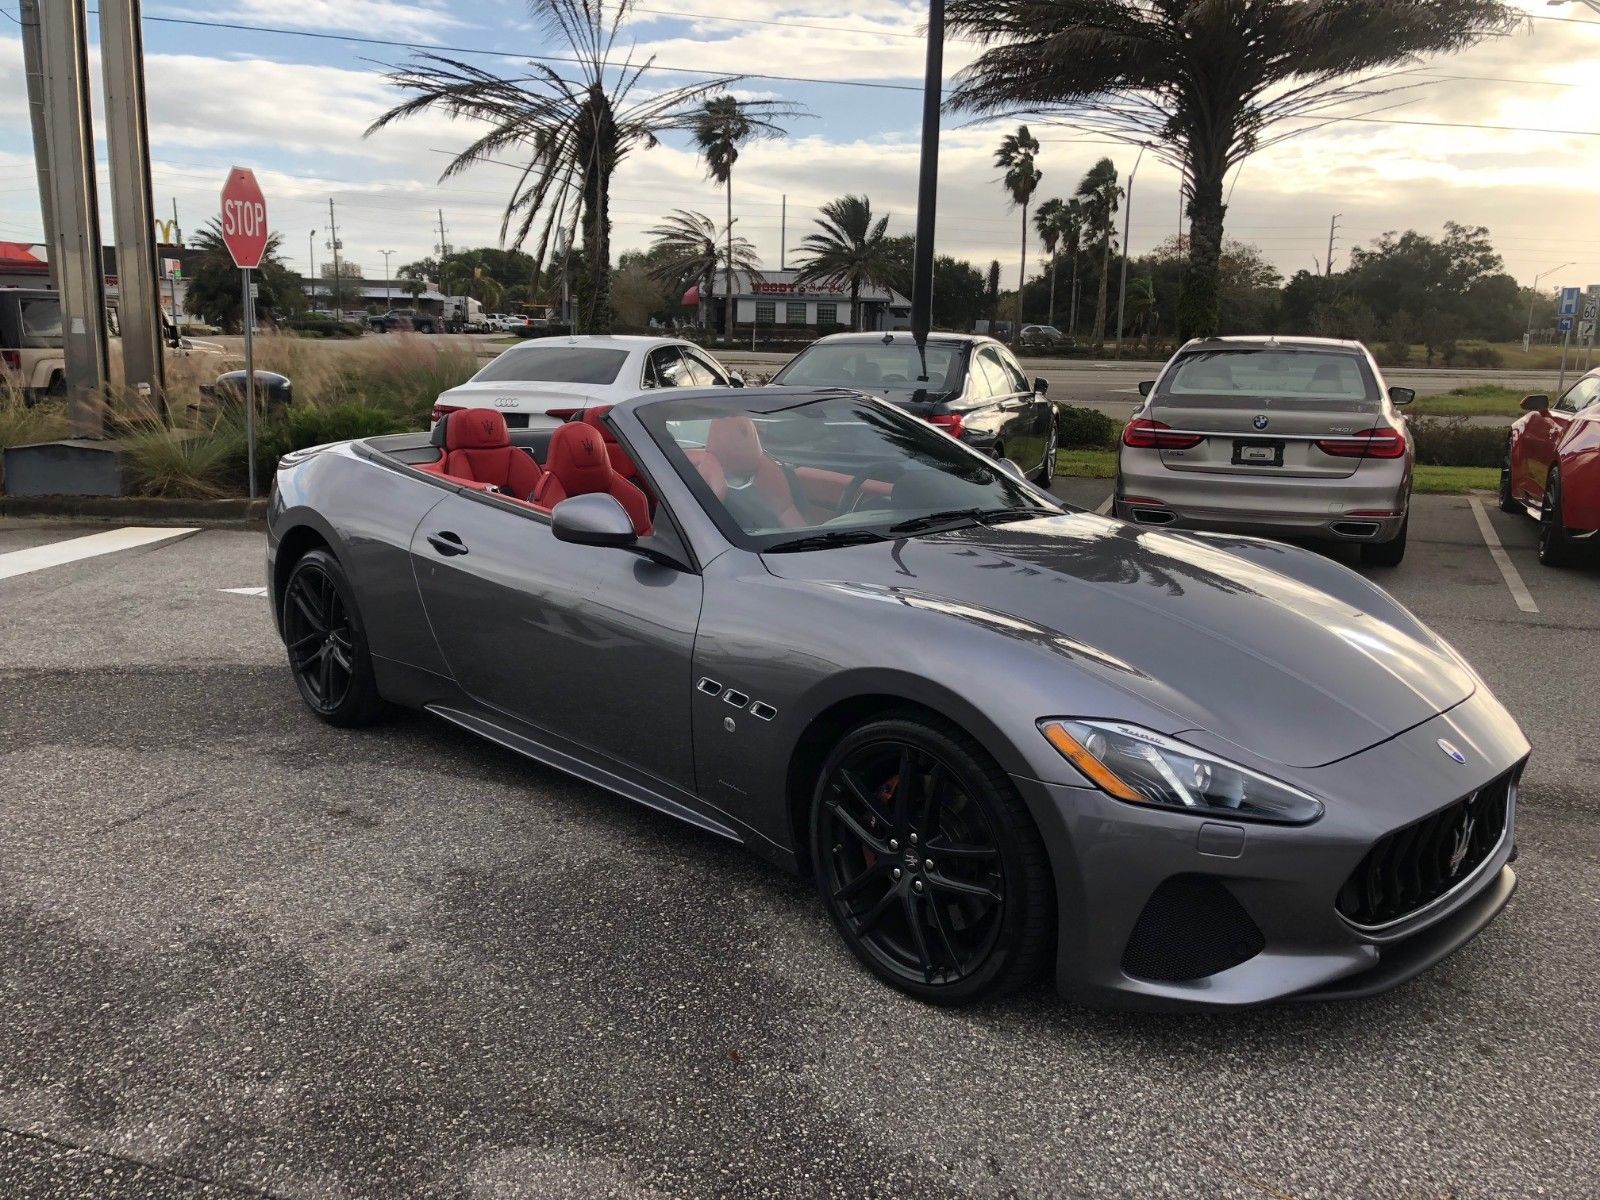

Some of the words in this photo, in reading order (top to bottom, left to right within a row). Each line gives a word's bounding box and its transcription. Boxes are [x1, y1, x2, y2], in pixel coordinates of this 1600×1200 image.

[225, 198, 264, 238] STOP
[1561, 289, 1578, 314] H
[1584, 306, 1596, 319] 60
